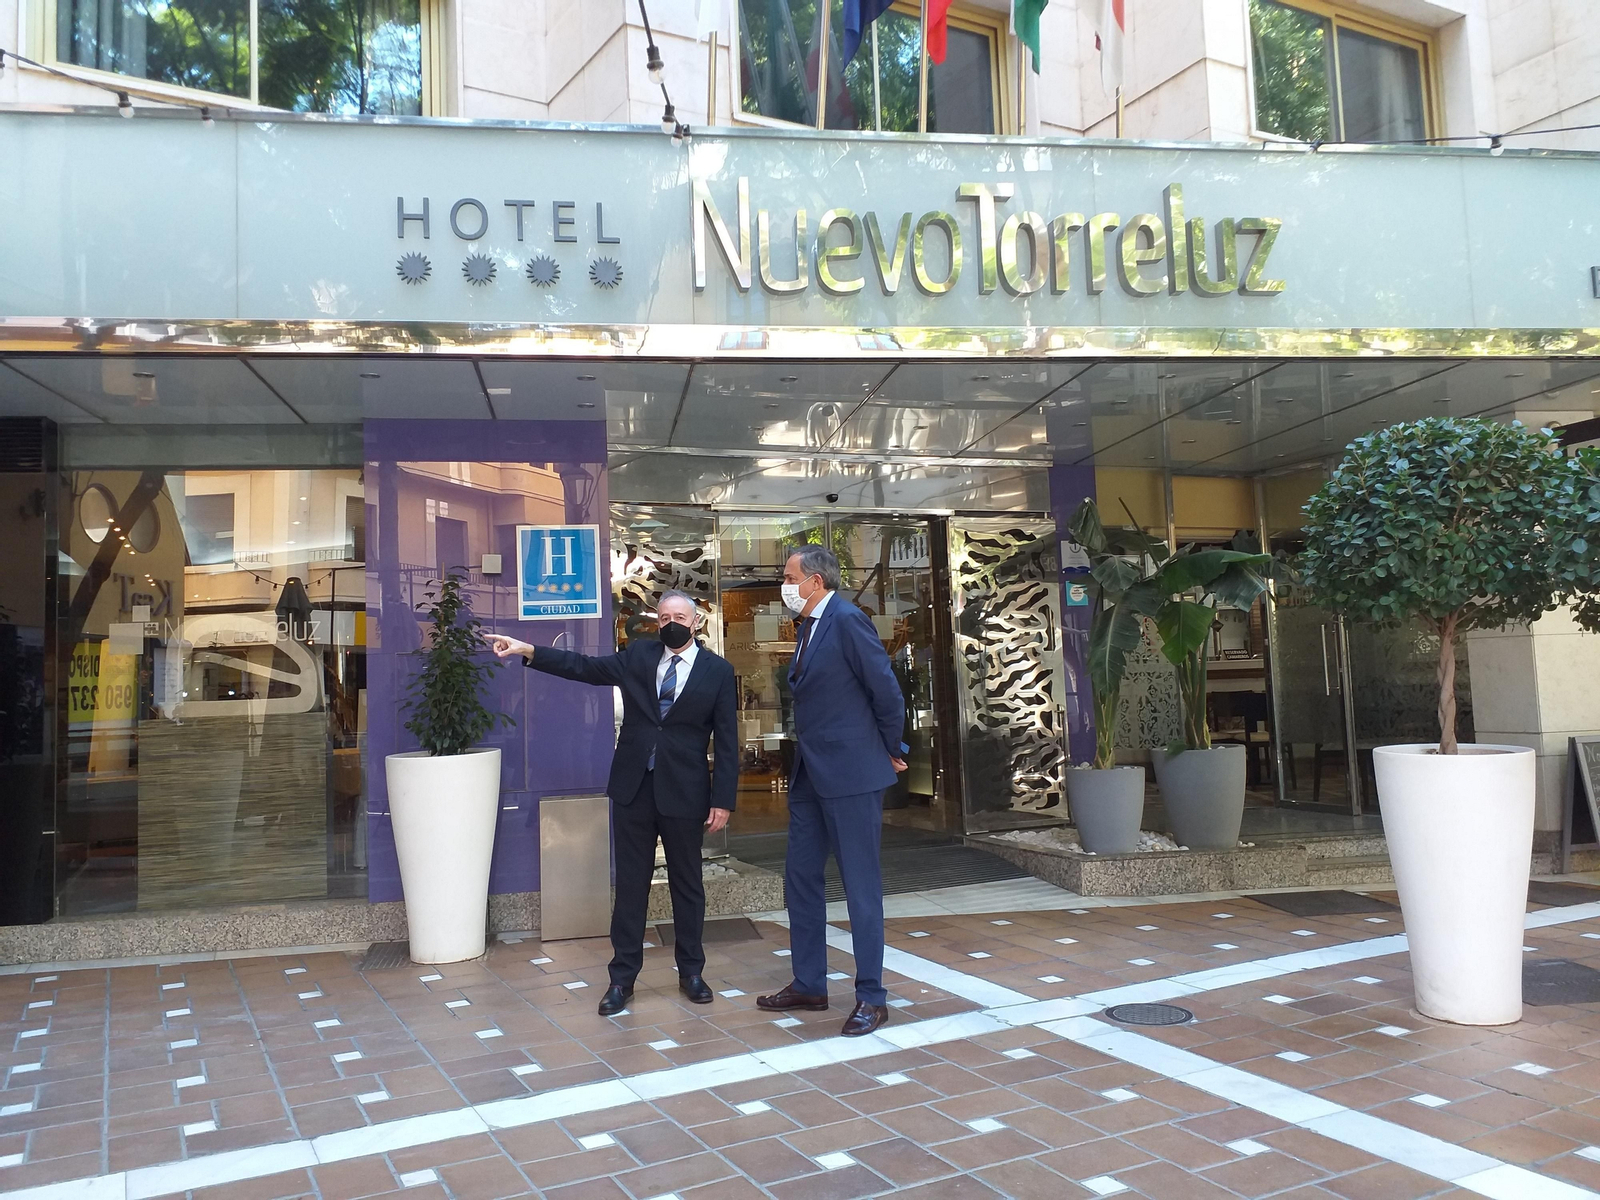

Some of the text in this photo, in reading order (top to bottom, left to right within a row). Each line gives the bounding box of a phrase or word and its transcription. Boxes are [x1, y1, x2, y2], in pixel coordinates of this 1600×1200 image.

[397, 196, 621, 244] HOTEL
[689, 177, 1286, 298] NuevoTorreluz
[540, 536, 577, 576] H
[540, 604, 581, 614] CIUDAD
